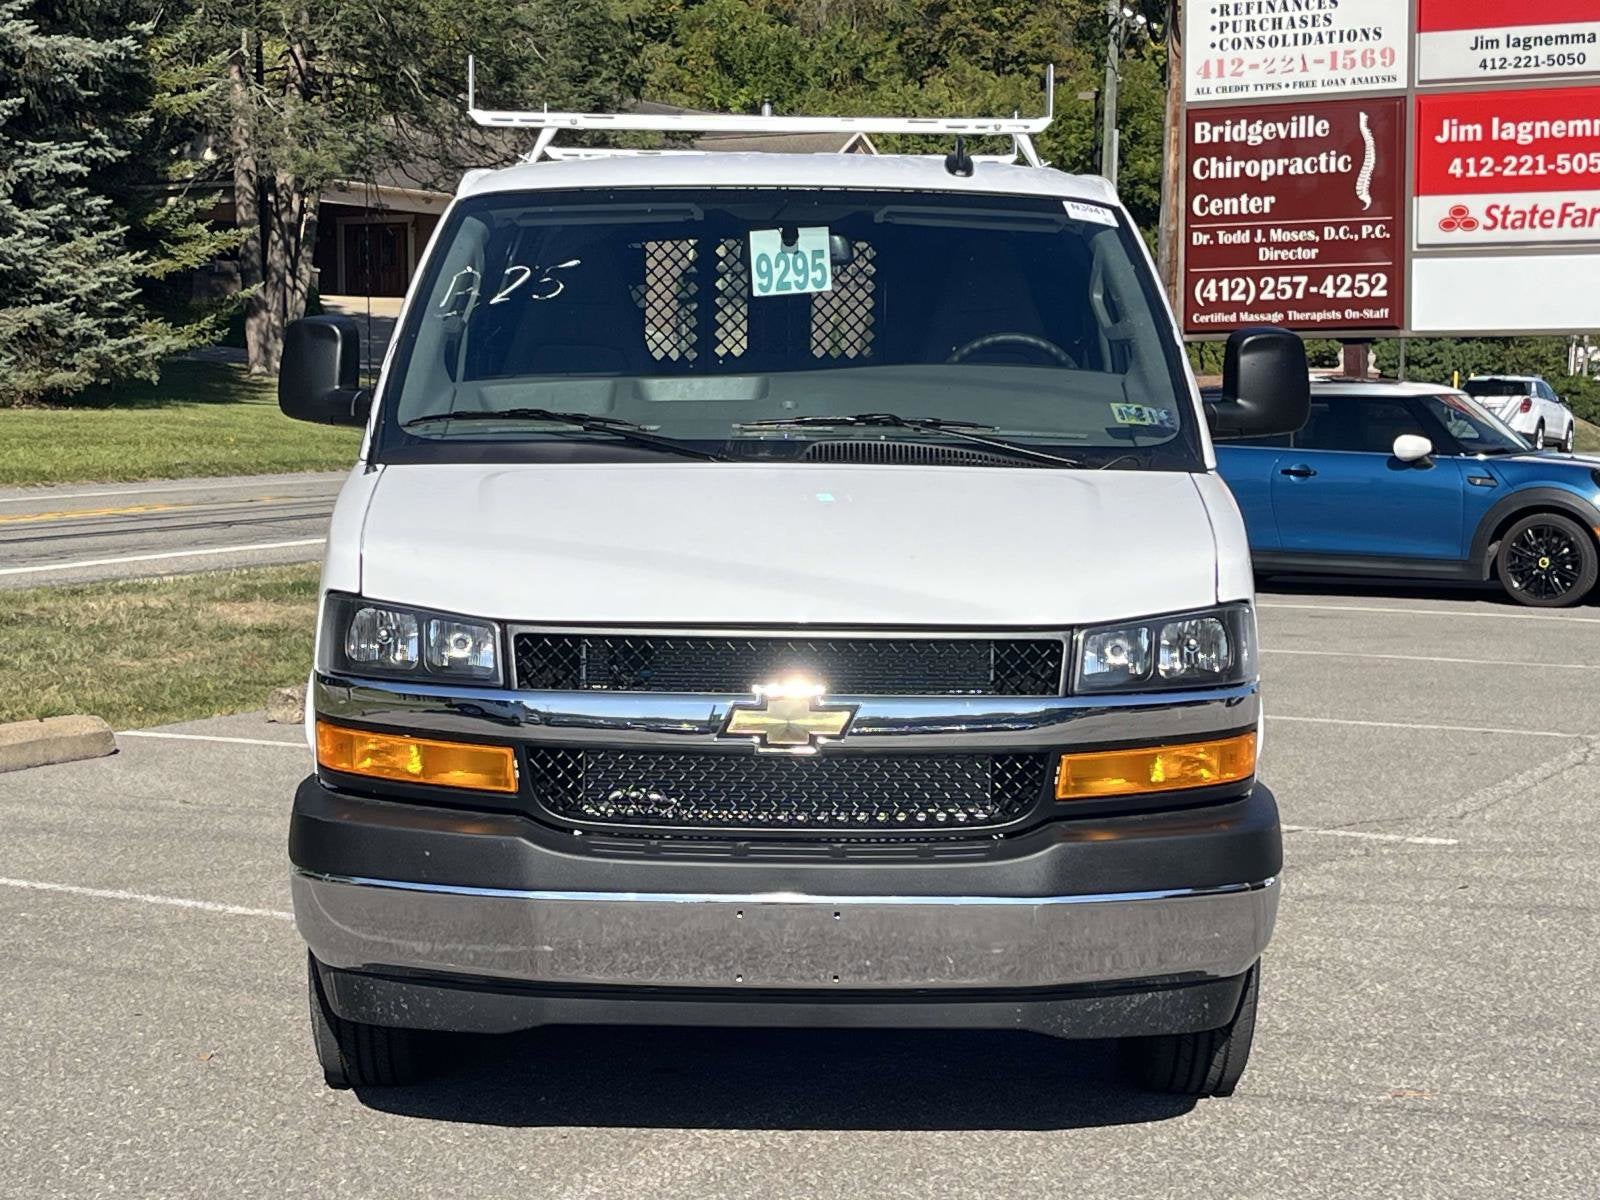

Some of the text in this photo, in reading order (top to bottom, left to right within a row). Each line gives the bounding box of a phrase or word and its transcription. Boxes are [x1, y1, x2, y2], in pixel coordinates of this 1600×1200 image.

[1219, 0, 1339, 16] REFINANCES
[1219, 13, 1333, 35] PURCHASES
[1219, 27, 1382, 51] CONSOLIDATIONS
[1469, 32, 1597, 51] Jim Iagnemma
[1196, 47, 1396, 79] 412-221-1569
[1478, 52, 1587, 70] 412-221-5050
[1195, 74, 1398, 95] ALL CREDIT TYPES FREE LOAN ANALYSIS
[1194, 115, 1330, 146] Bridgeville
[1434, 116, 1600, 145] Jim Iagnem
[1192, 150, 1352, 182] Chiropractic
[1192, 193, 1277, 217] Center
[1192, 224, 1391, 246] Dr. Todd J. Moses, D.C., P.C.
[1258, 246, 1319, 261] Director
[756, 250, 827, 293] 9295
[1194, 272, 1389, 307] (412) 257-4252
[1192, 307, 1390, 324] Certified Massage Therapists On-Staff
